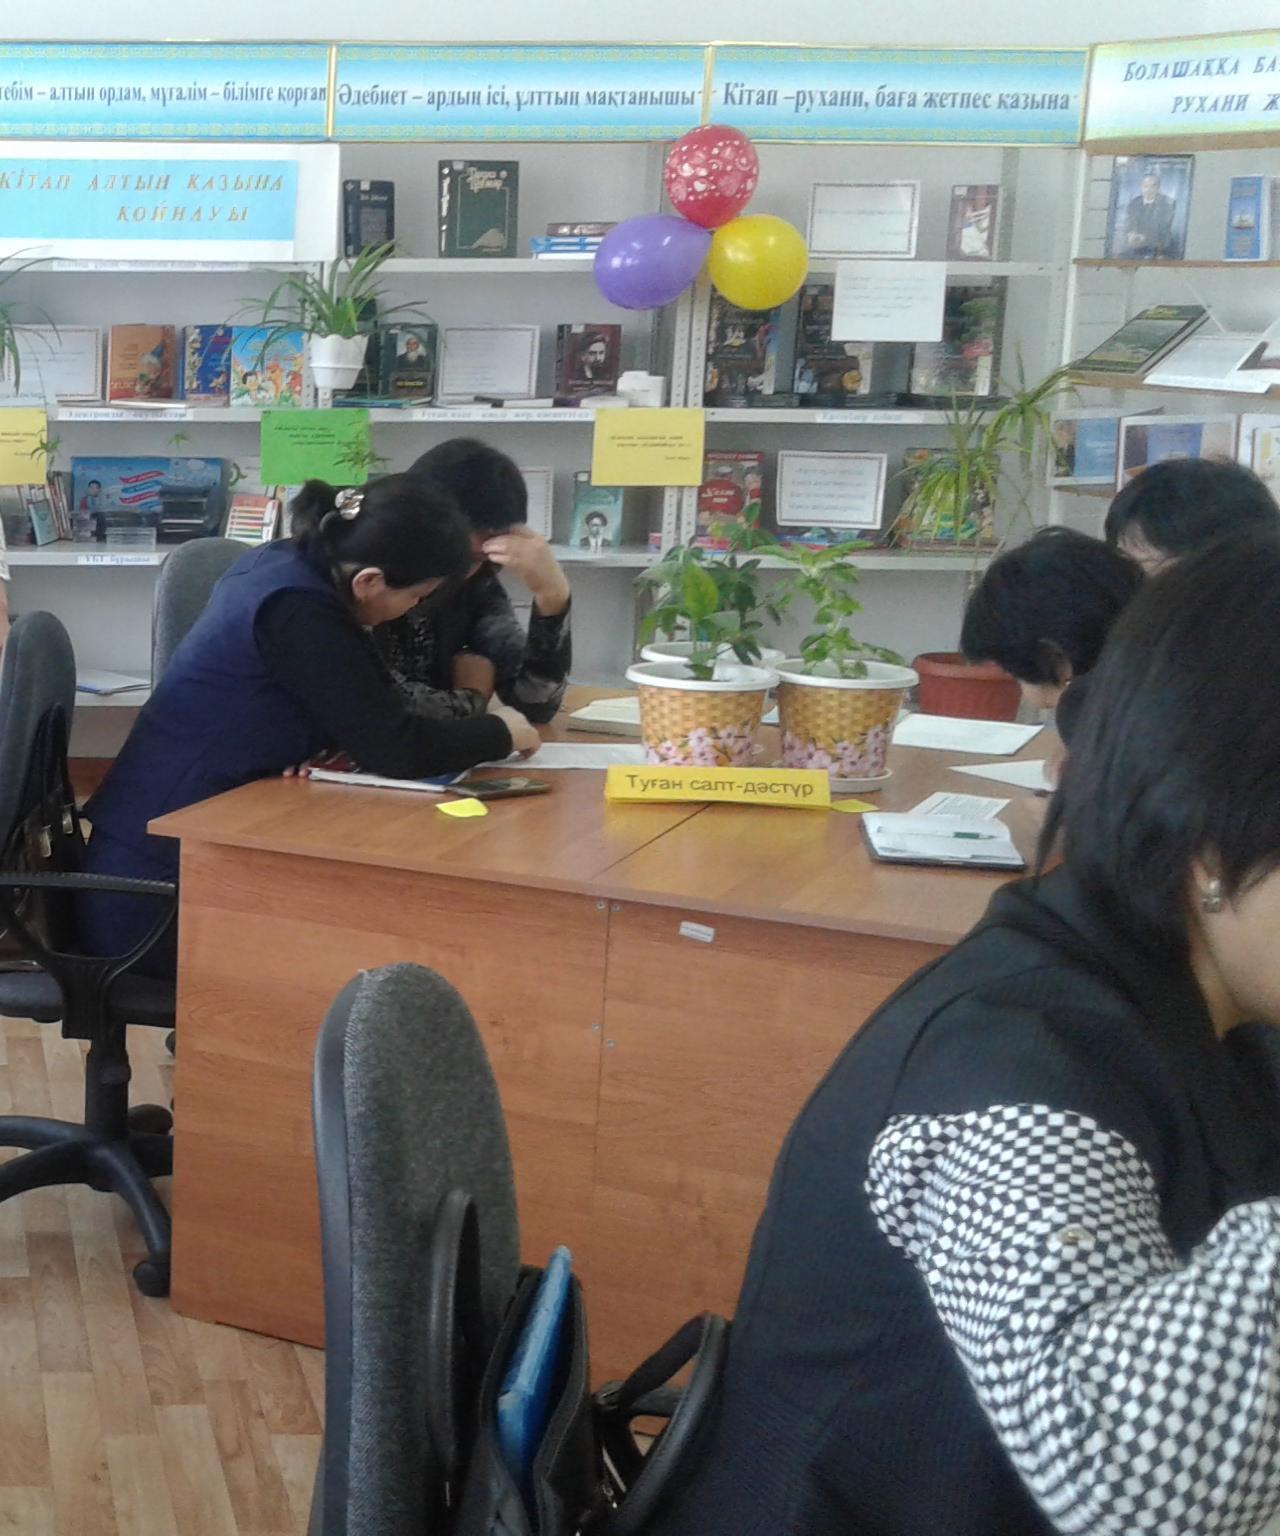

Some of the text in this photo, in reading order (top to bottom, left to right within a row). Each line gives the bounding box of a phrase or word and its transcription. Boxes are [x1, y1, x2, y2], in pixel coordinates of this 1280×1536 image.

[50, 86, 95, 101] алтын
[223, 81, 273, 102] білімге
[338, 84, 407, 107] Әдебиет
[723, 82, 778, 106] Кітап
[922, 91, 992, 109] жетпес
[1170, 94, 1250, 114] РУХАНИ
[88, 174, 171, 191] АЛТЫН
[626, 774, 814, 798] Туған салт-дәстүр
